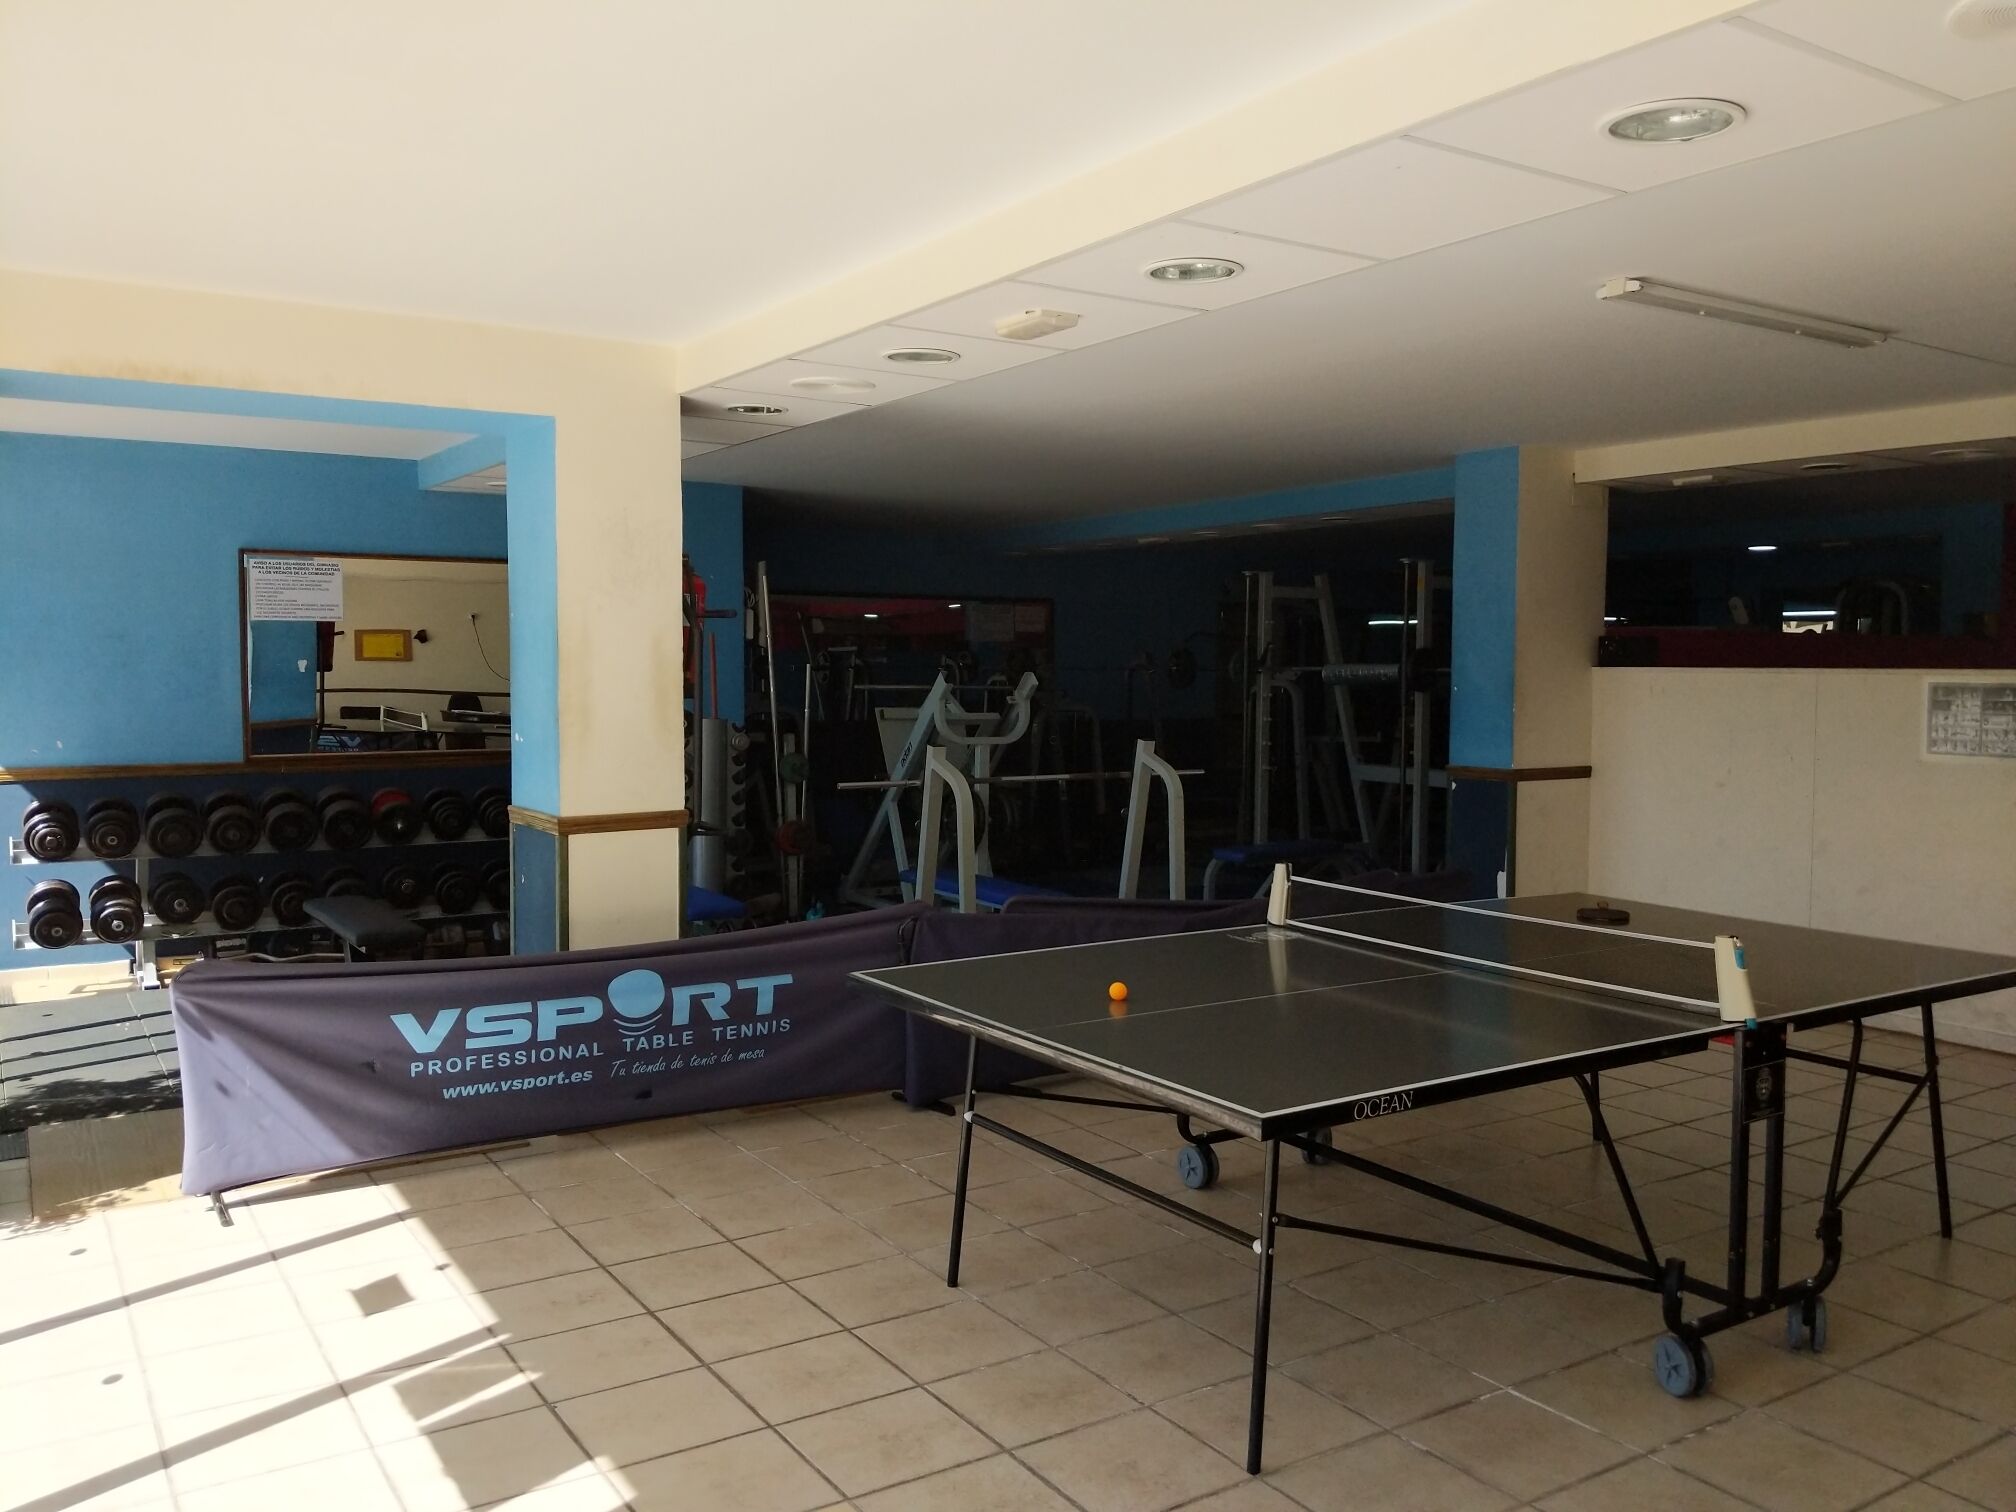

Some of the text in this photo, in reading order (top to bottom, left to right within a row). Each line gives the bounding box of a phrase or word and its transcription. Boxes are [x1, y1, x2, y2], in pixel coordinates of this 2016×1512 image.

[390, 969, 793, 1054] VSPORT
[410, 1018, 791, 1078] PROFESSIONAL TABLE TENNIS
[610, 1047, 766, 1079] Tu tienda de tenis de mesa
[442, 1070, 593, 1100] www.vsport.es
[1353, 1090, 1414, 1120] OCEAN
